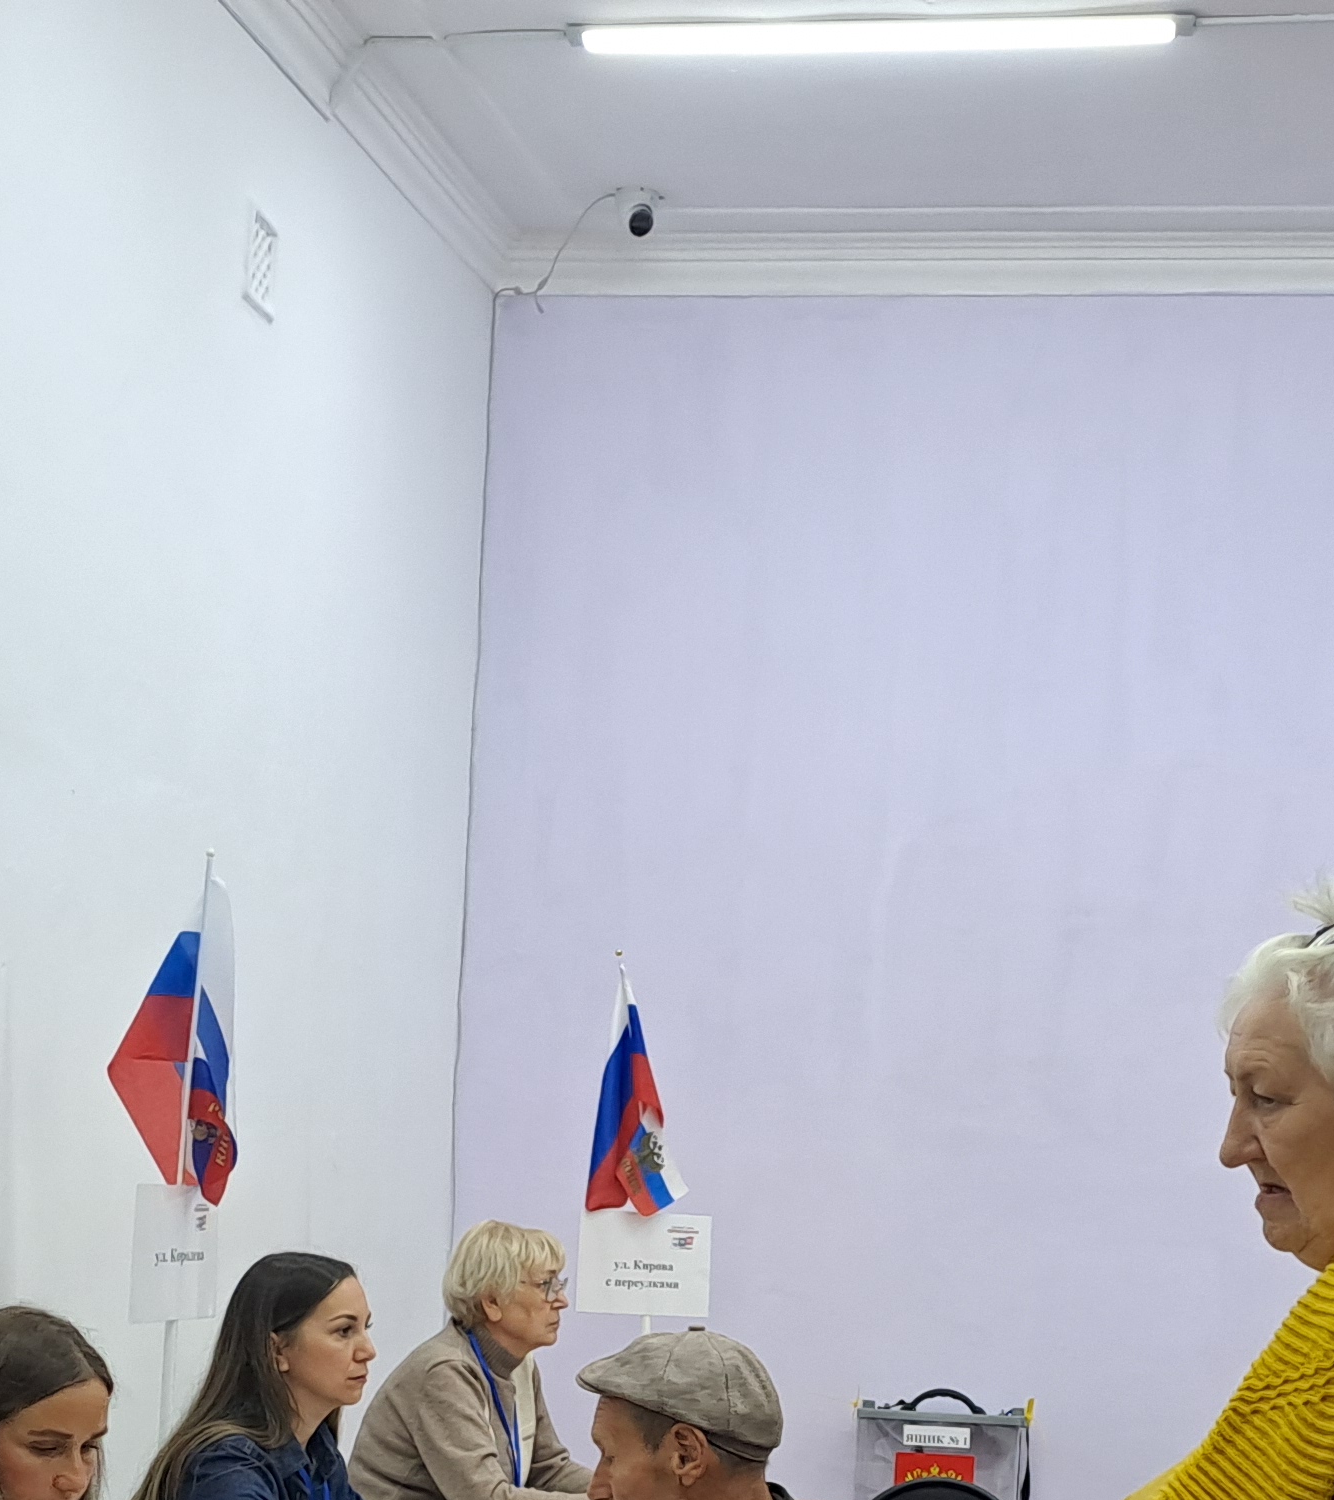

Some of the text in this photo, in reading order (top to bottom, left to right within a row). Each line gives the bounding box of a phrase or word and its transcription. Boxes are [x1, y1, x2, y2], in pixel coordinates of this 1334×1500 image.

[614, 1260, 673, 1273] ул. Кирова
[615, 1279, 678, 1290] переулками
[905, 1433, 945, 1445] ЯЩИК
